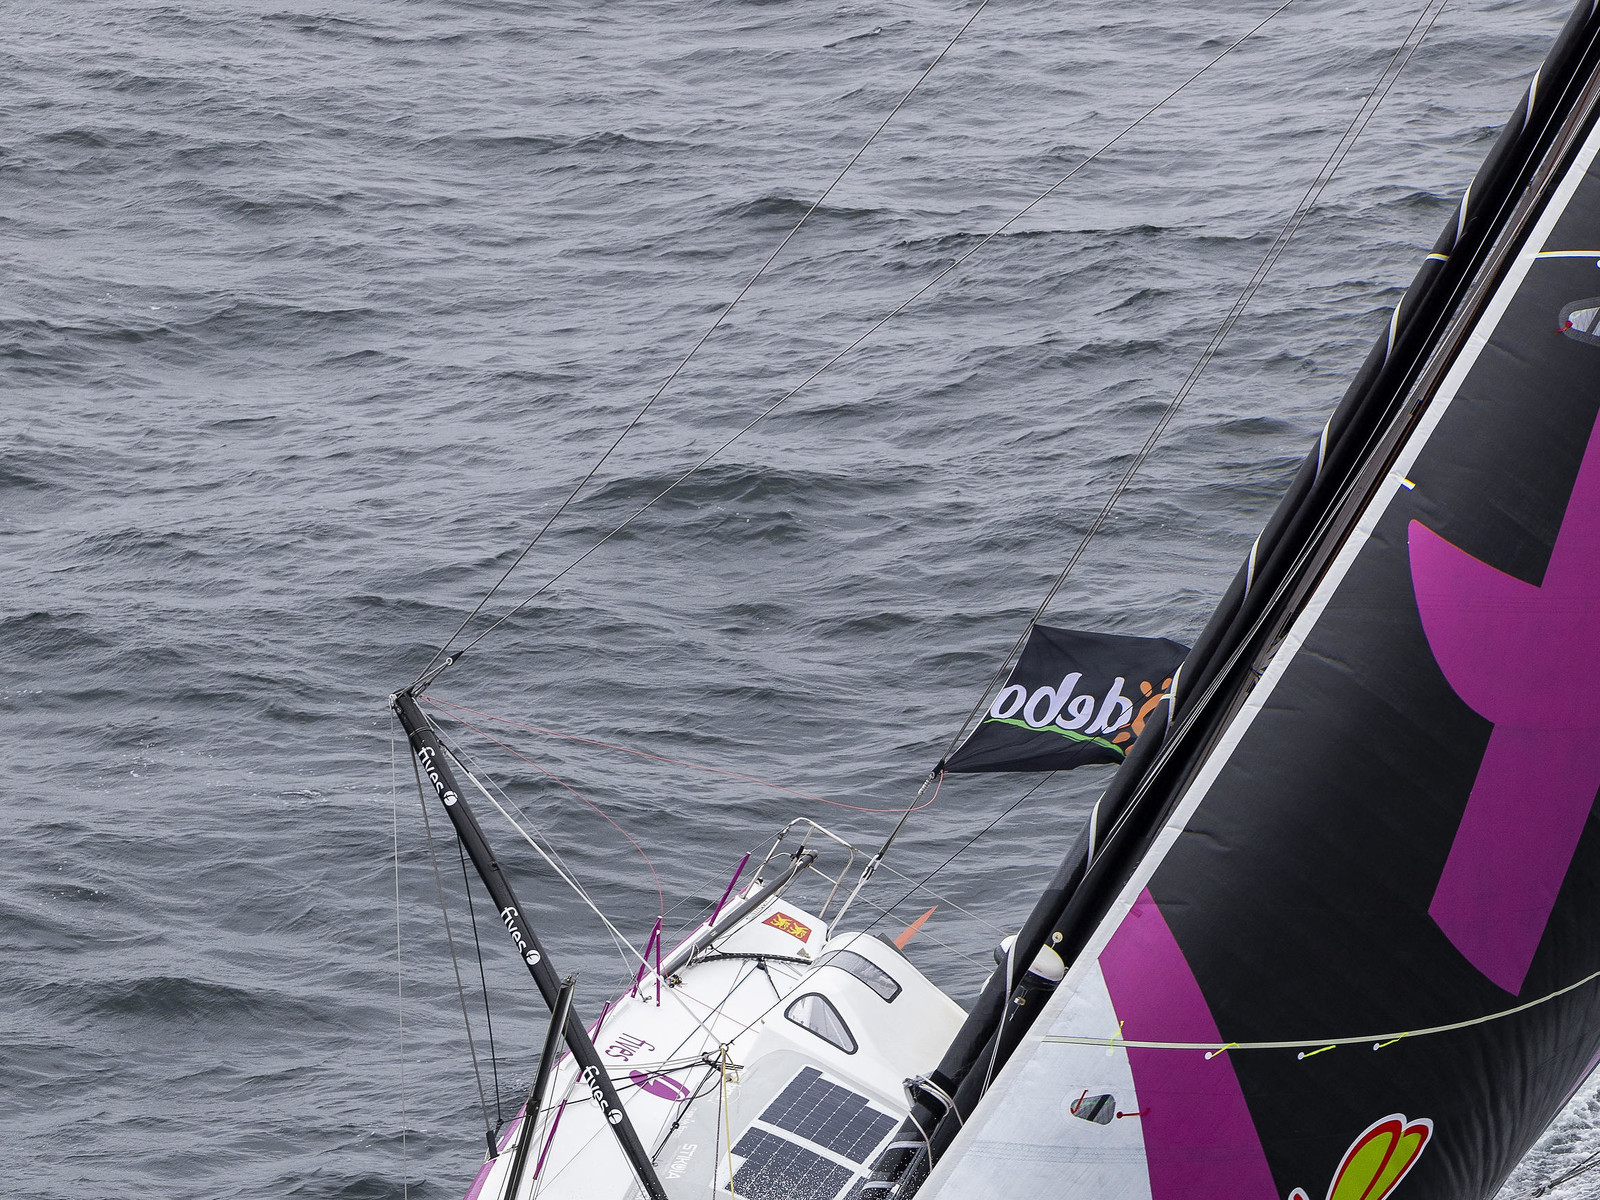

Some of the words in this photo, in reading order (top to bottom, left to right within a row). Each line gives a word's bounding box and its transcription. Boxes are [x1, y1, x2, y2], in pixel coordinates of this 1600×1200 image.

[417, 745, 444, 794] fives
[500, 906, 527, 954] fives
[604, 1031, 656, 1063] fives
[583, 1064, 610, 1113] fives
